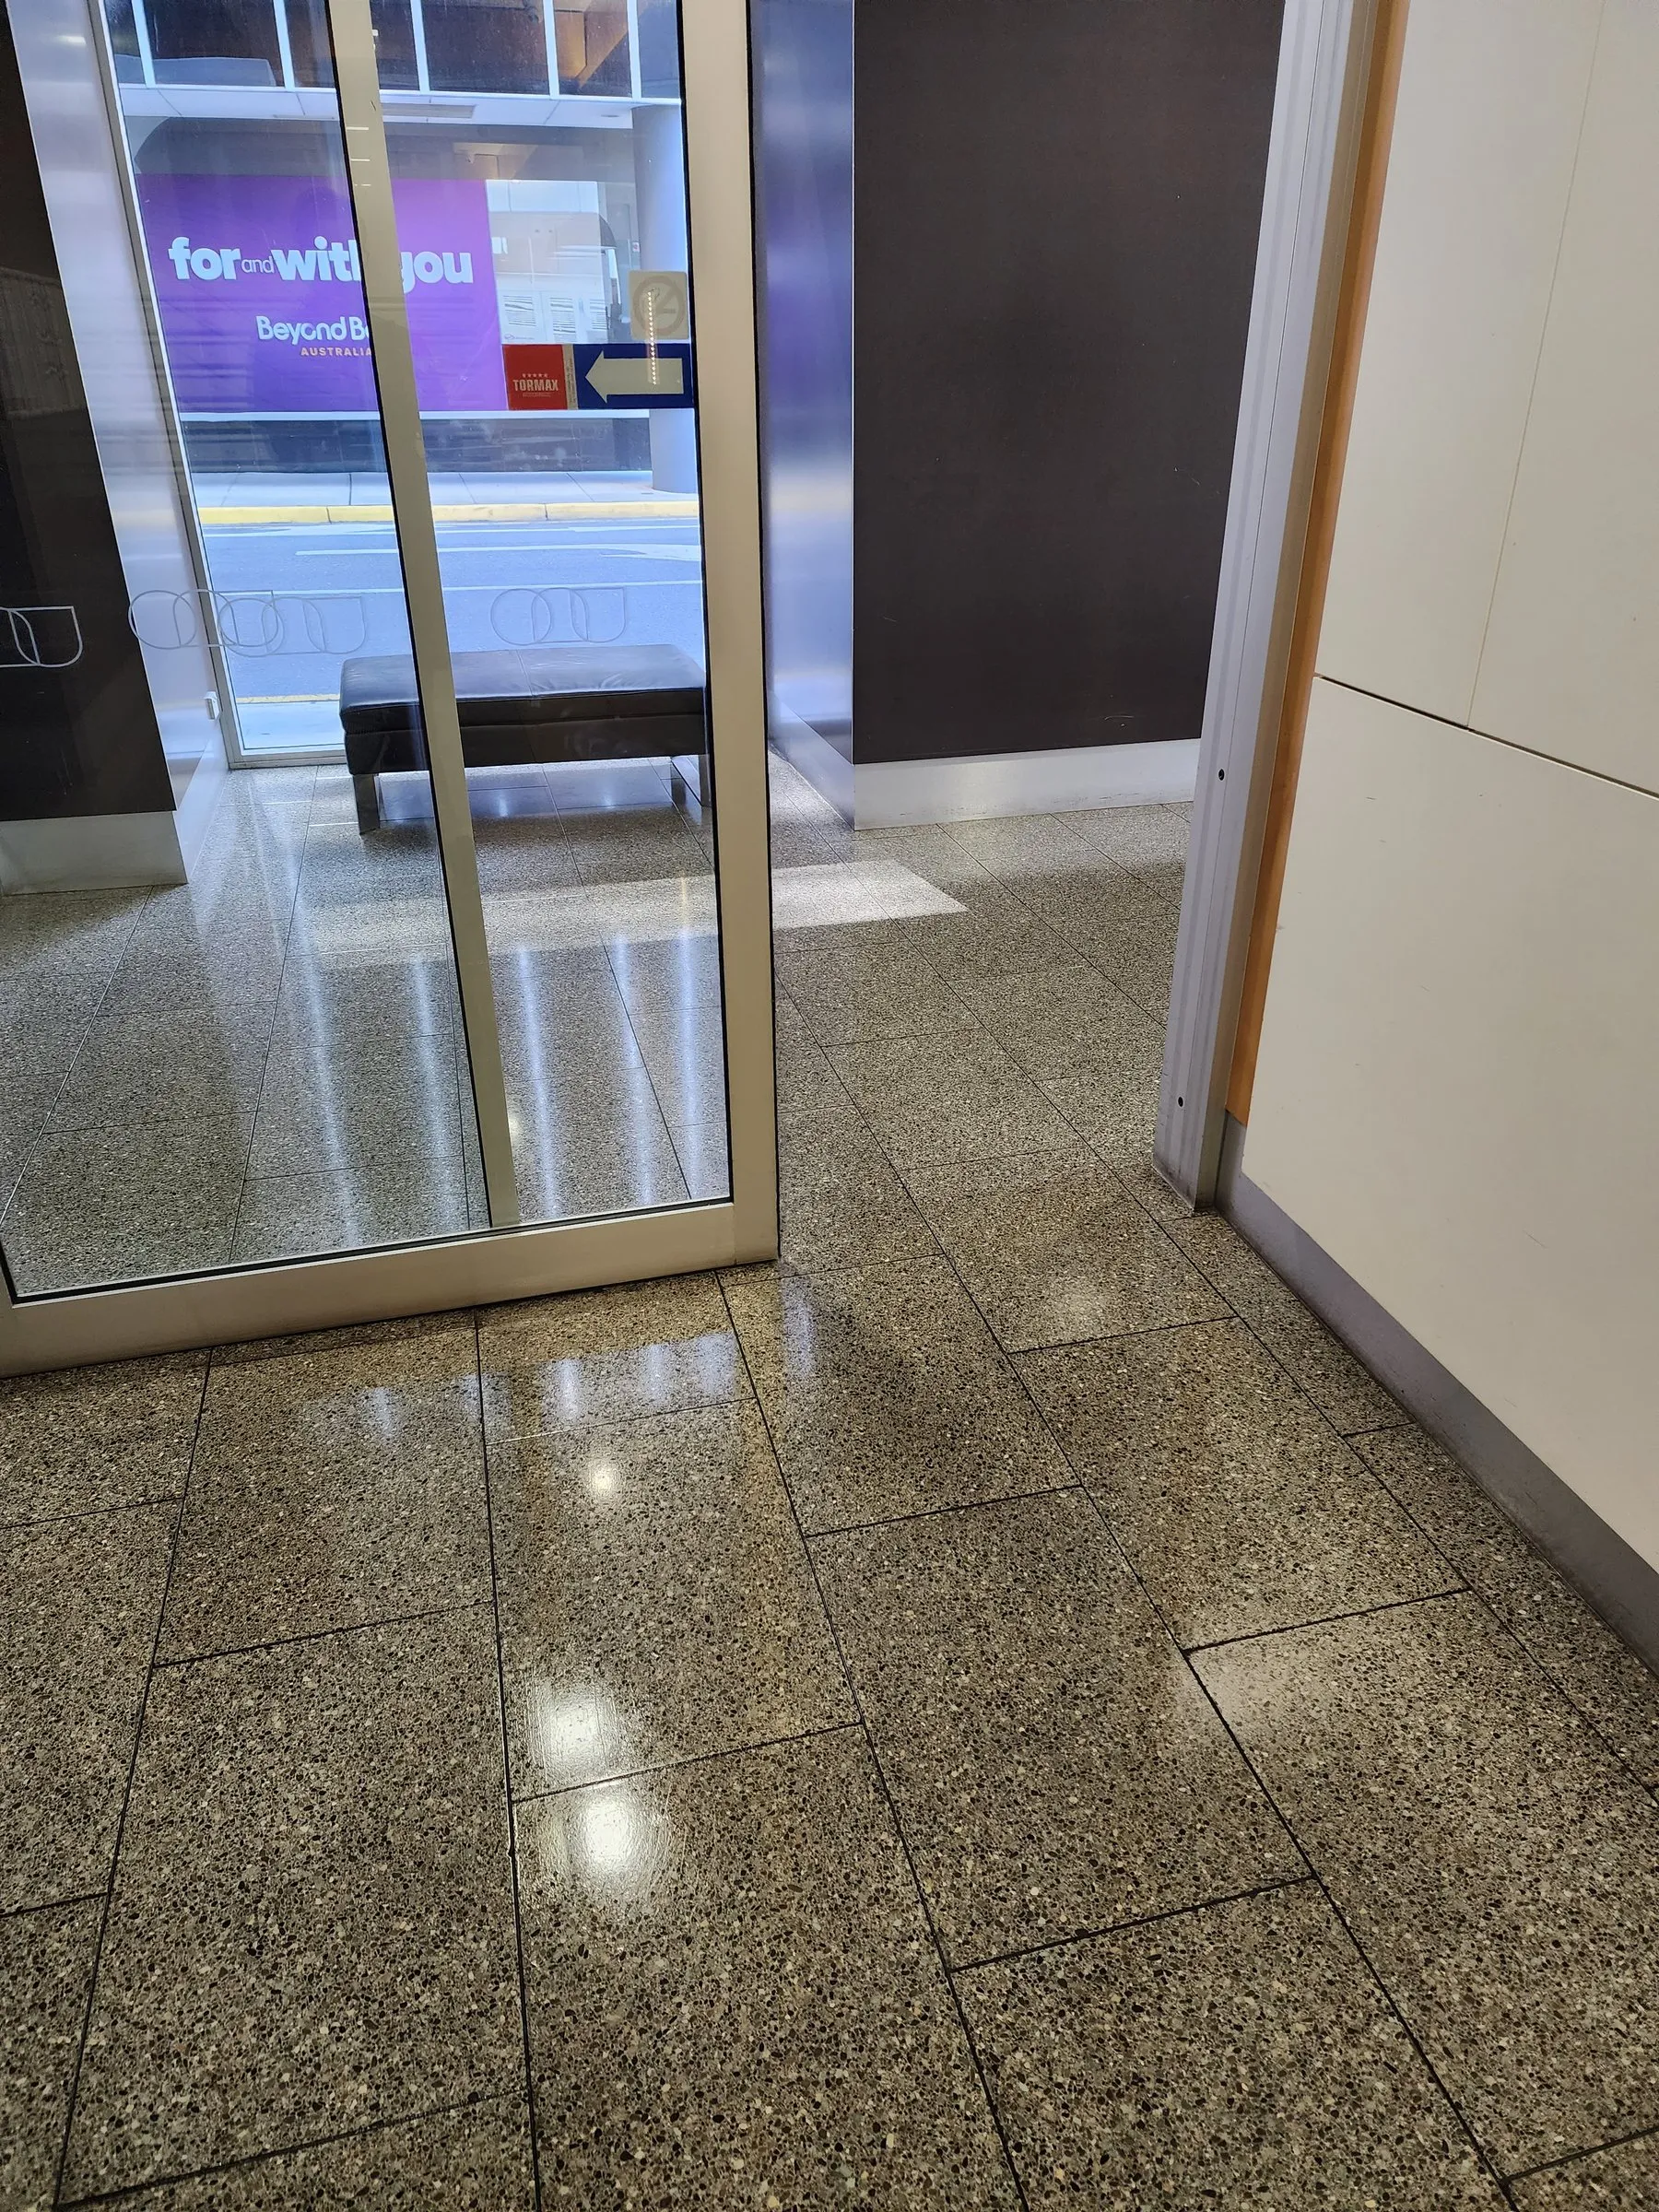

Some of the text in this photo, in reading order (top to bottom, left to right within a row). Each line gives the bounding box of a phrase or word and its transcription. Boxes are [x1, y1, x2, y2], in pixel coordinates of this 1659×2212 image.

[168, 236, 241, 280] for
[241, 256, 275, 274] and
[255, 315, 347, 346] Beyond
[300, 347, 372, 357] AUSTRALIA
[512, 379, 559, 392] TORMAX
